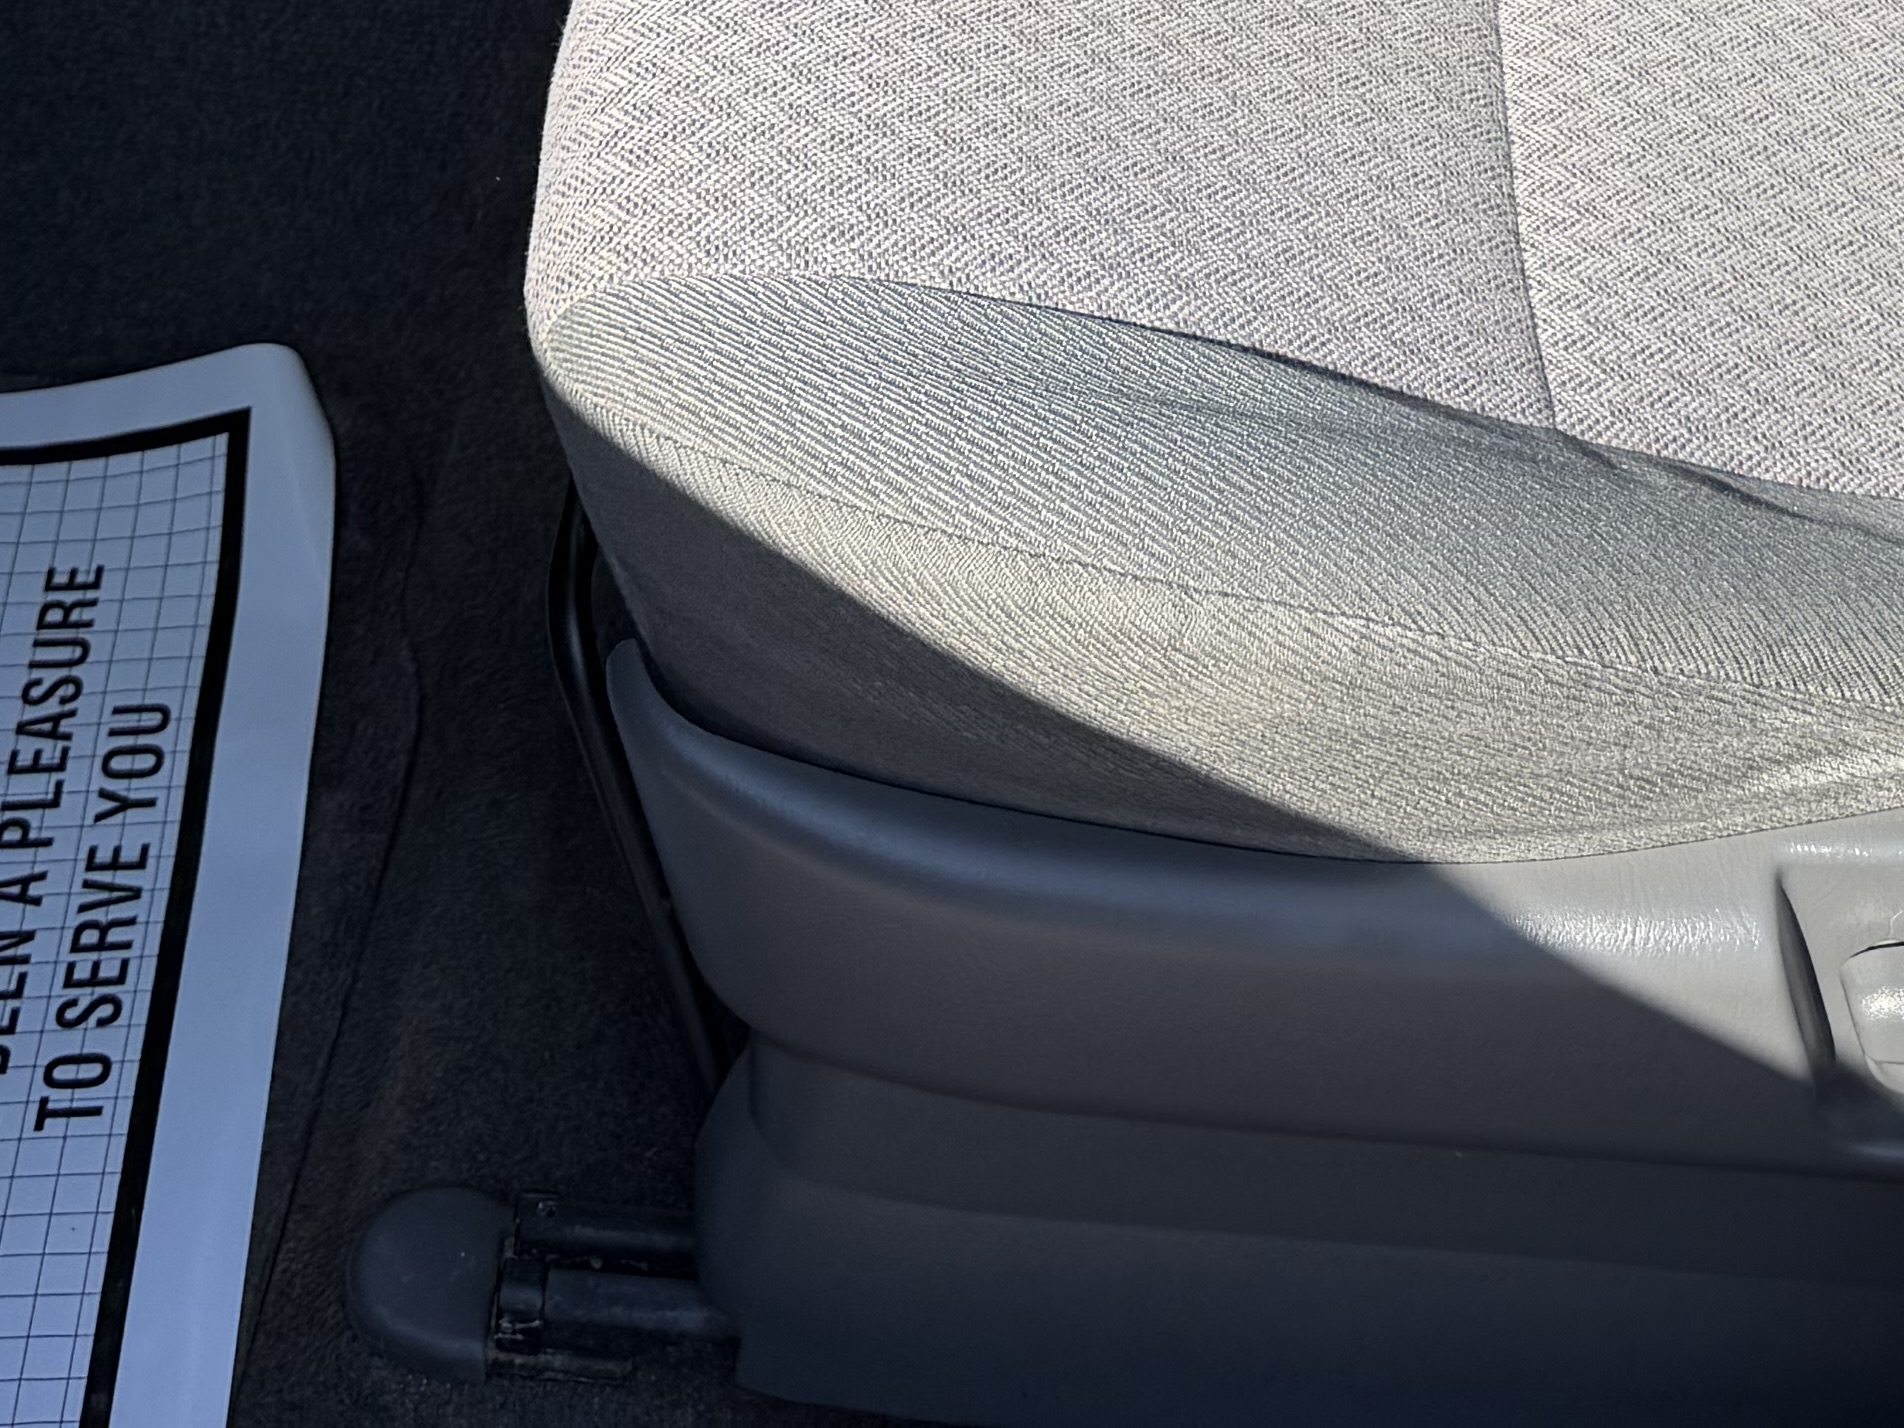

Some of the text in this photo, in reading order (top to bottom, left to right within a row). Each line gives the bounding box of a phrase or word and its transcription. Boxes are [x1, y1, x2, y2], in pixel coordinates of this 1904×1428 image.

[33, 702, 172, 1132] TO SERVE YOU
